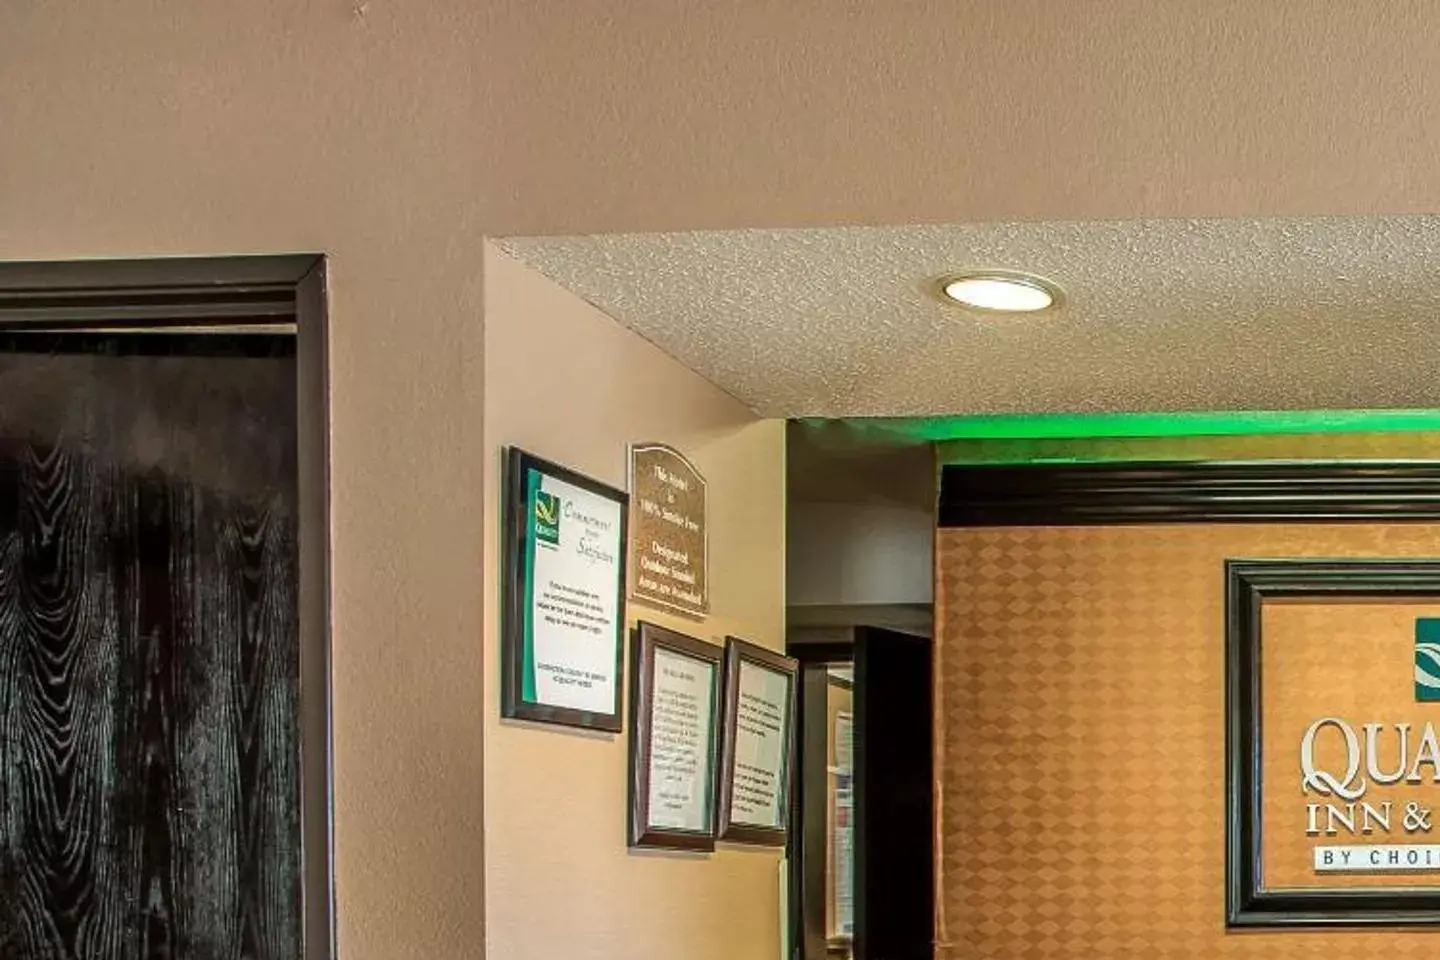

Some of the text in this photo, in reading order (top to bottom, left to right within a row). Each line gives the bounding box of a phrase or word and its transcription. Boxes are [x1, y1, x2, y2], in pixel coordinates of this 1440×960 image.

[1305, 801, 1392, 834] INN
[1403, 800, 1432, 832] &
[1323, 850, 1351, 865] BY
